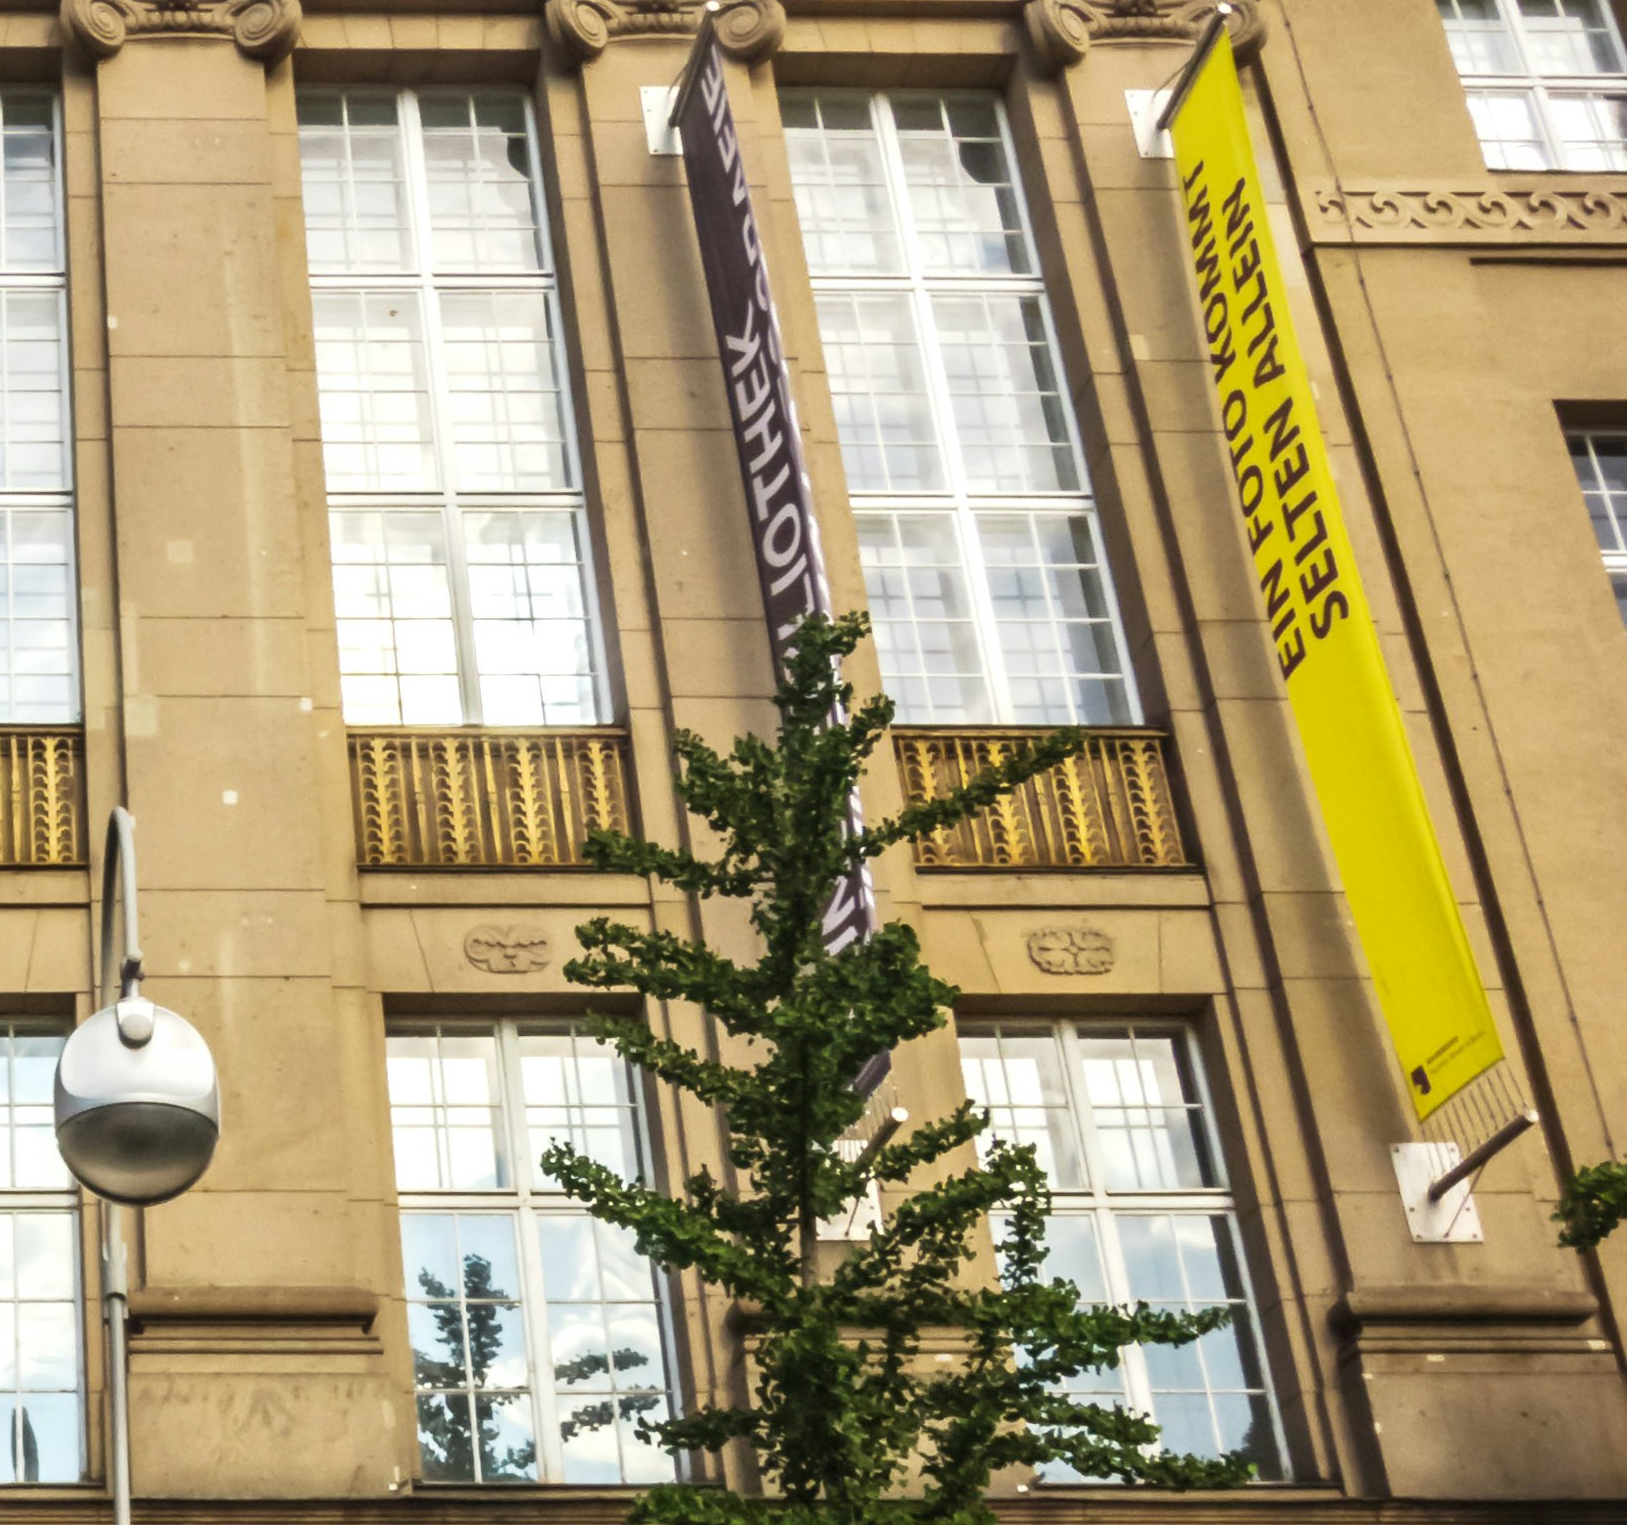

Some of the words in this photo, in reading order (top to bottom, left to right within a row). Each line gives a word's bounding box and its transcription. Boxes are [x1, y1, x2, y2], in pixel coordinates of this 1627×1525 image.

[1182, 159, 1237, 385] KOMMT
[1221, 176, 1286, 389] ALLEIN
[1223, 388, 1275, 556] FOTO
[1263, 396, 1350, 641] SELTEN
[1260, 557, 1307, 681] EIN
